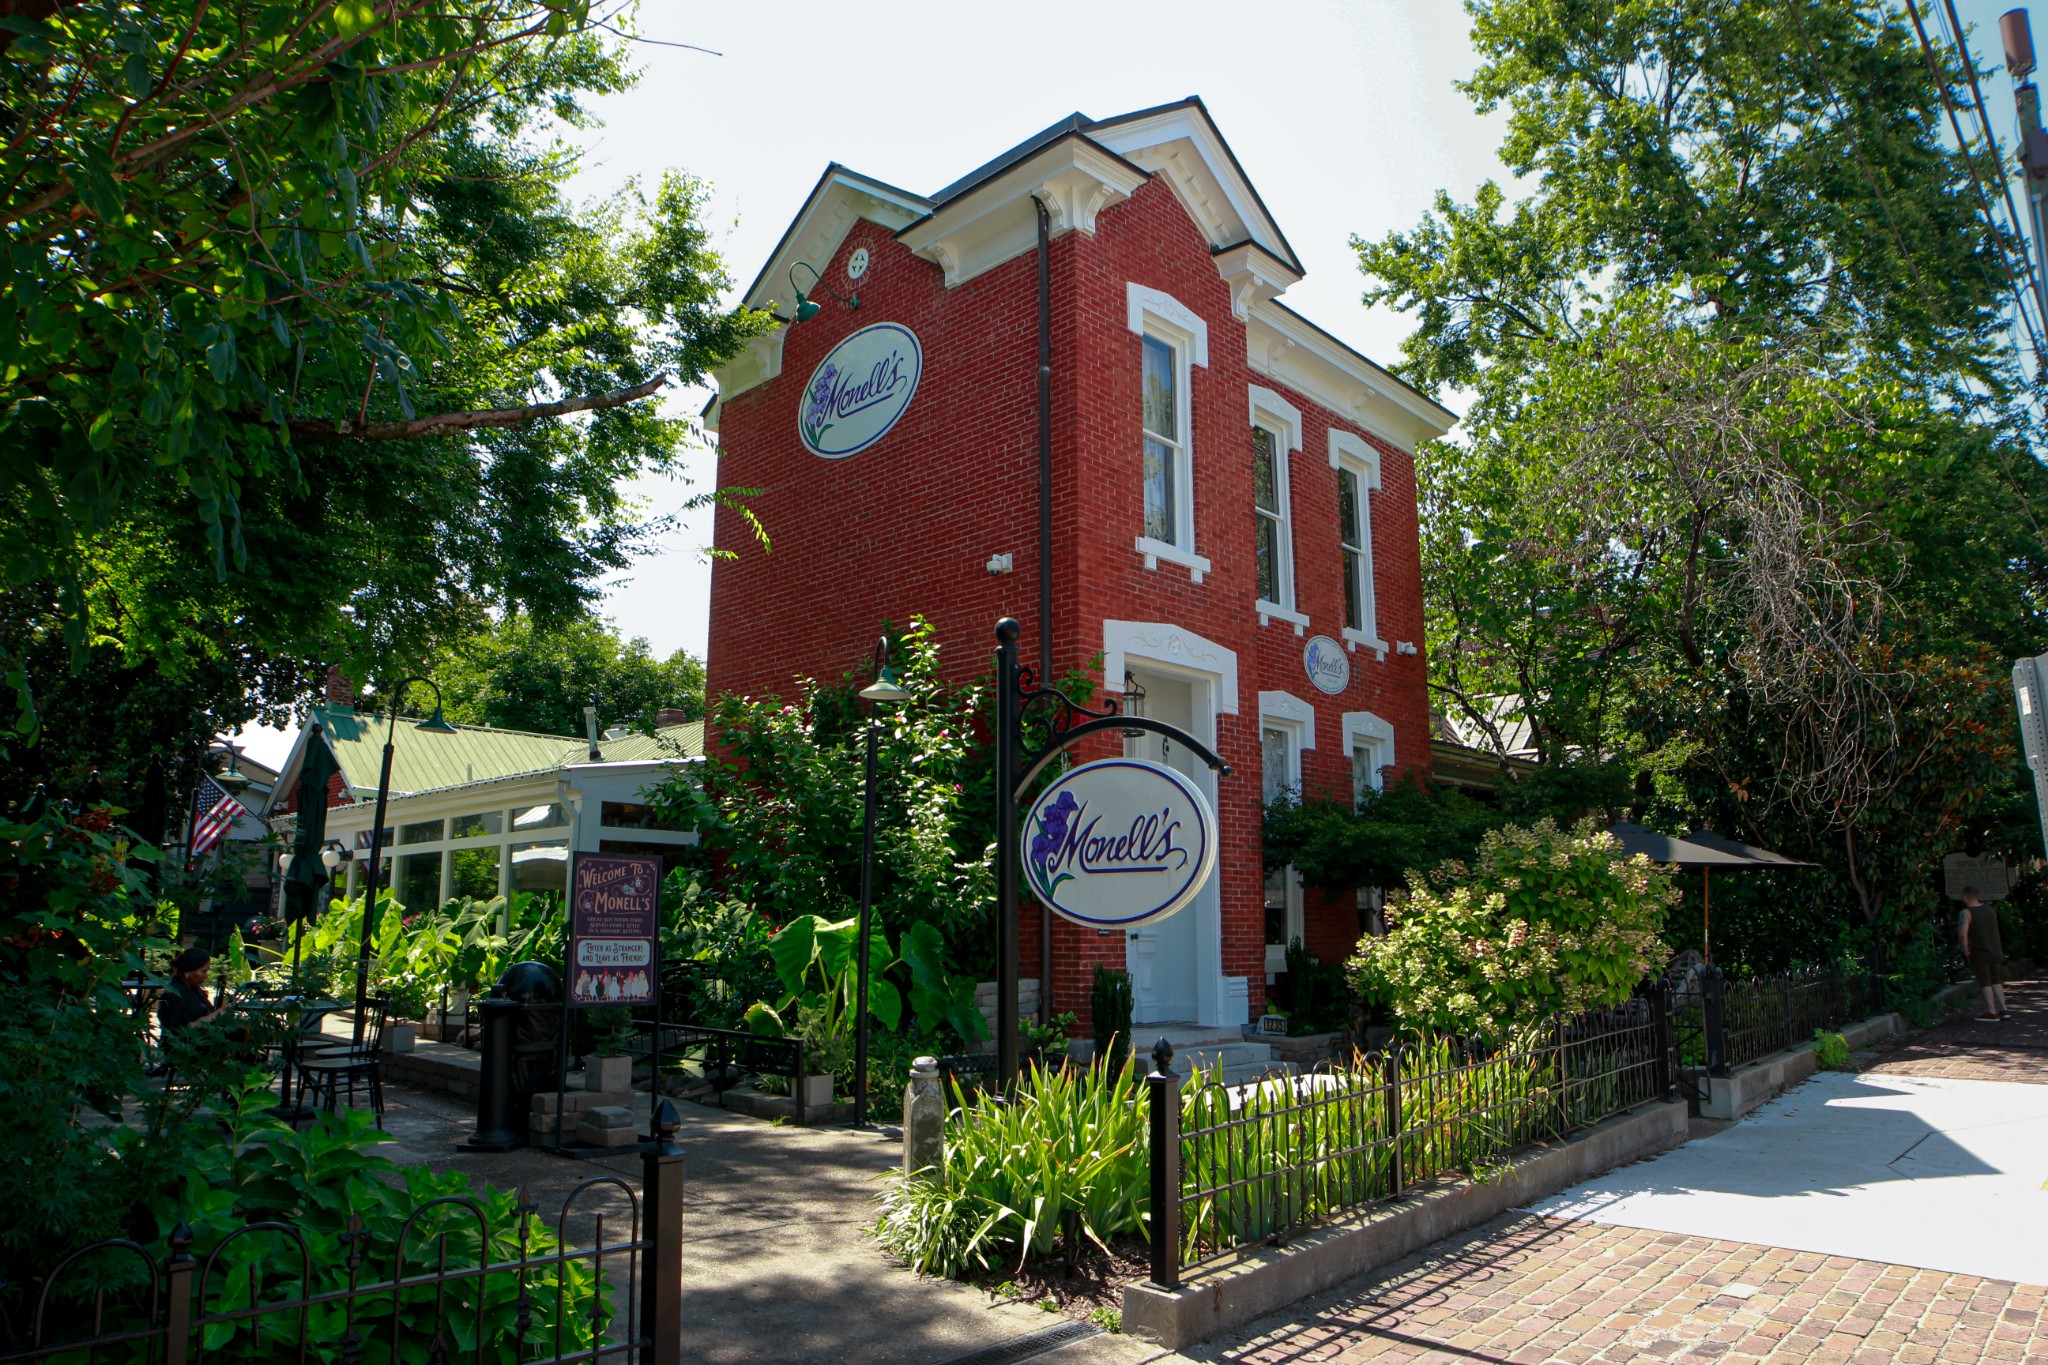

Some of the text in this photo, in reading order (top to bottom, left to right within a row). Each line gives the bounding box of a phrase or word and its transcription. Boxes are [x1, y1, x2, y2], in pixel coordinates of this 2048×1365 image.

[816, 350, 908, 428] Monell's
[1312, 648, 1345, 679] Monell's
[1047, 800, 1188, 873] Monell's
[580, 862, 644, 888] WELCOME TO
[594, 891, 650, 914] MONELL'S
